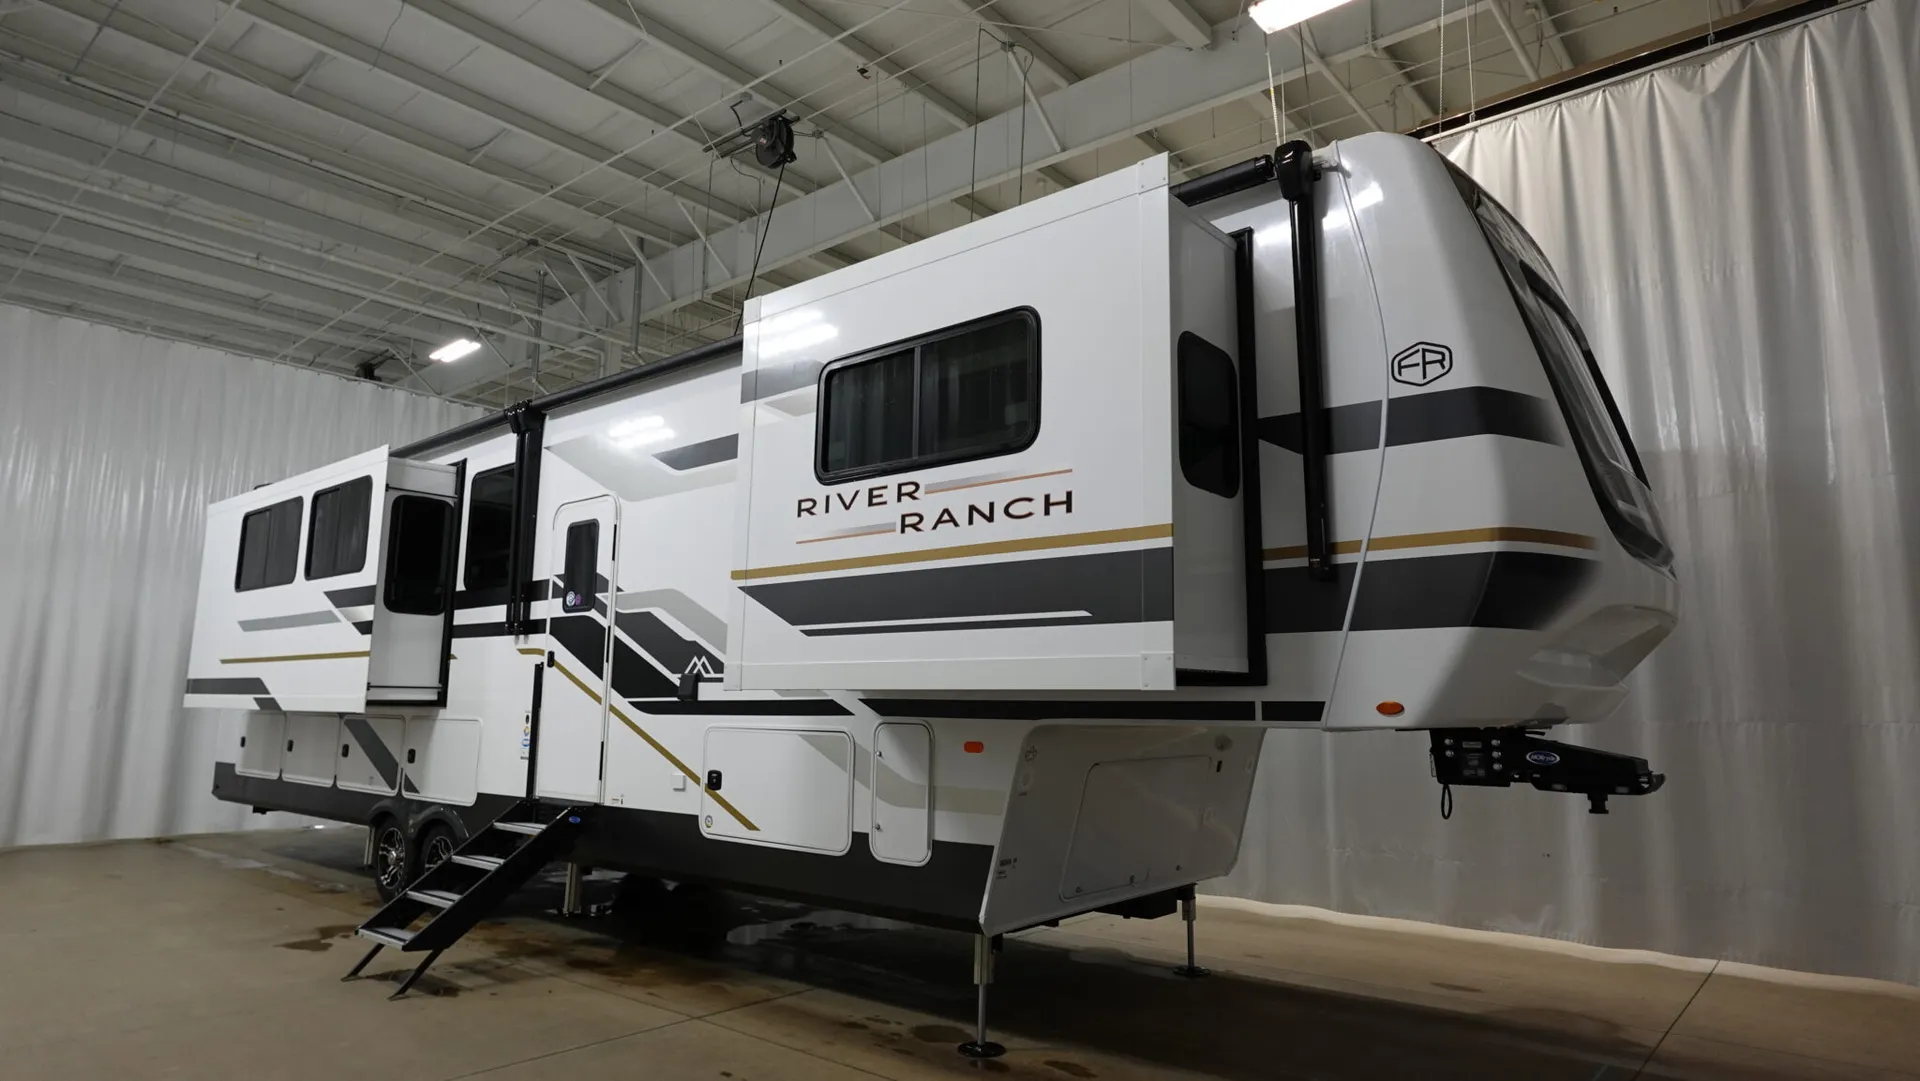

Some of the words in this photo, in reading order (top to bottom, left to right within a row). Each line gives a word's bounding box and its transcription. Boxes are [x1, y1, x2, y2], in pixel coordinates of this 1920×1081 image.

[1398, 348, 1445, 380] FR
[797, 481, 920, 518] RIVER
[900, 490, 1073, 534] RANCH
